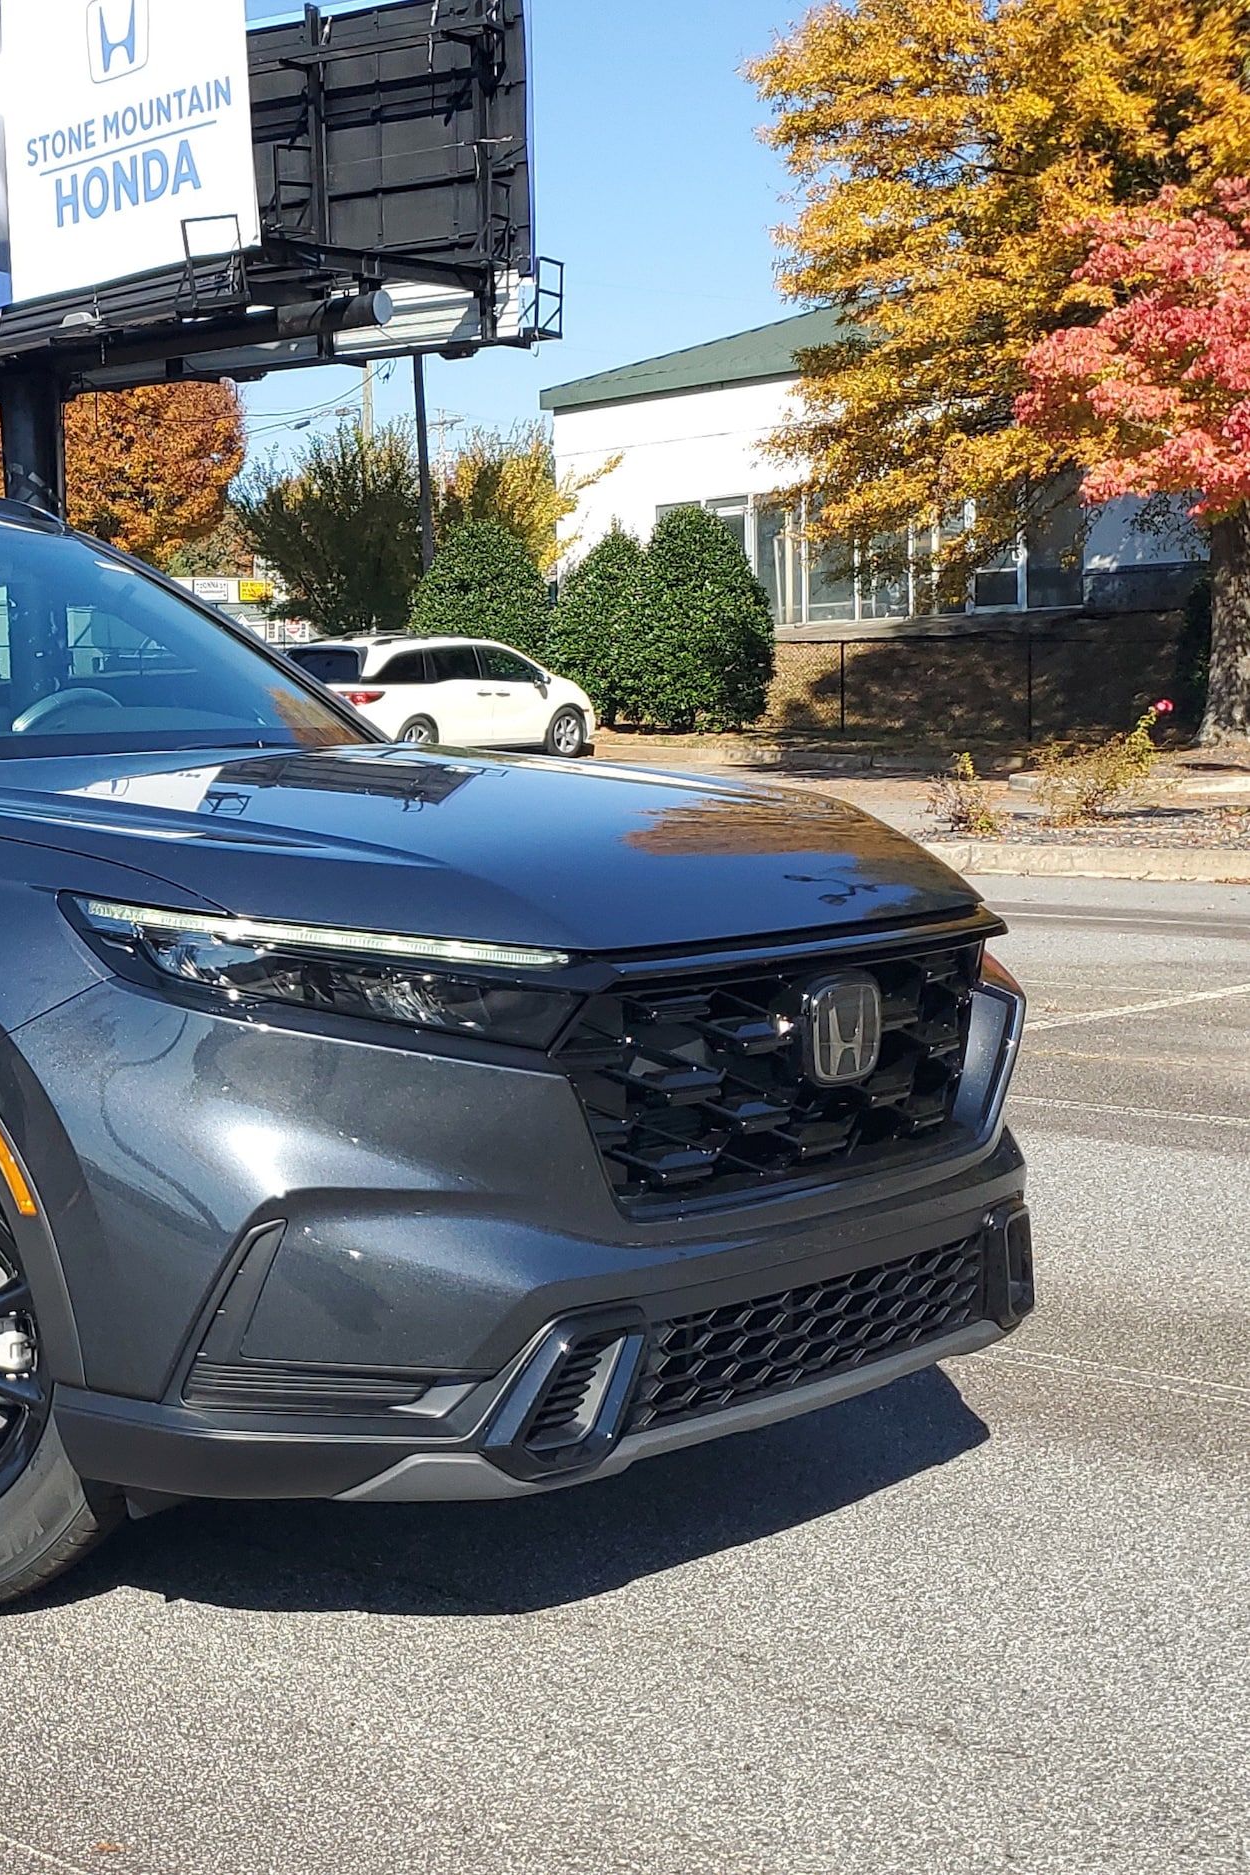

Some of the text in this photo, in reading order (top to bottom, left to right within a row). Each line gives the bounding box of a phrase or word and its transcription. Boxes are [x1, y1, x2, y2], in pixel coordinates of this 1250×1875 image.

[27, 75, 232, 167] STONE MOUNTAIN
[55, 139, 202, 228] HONDA
